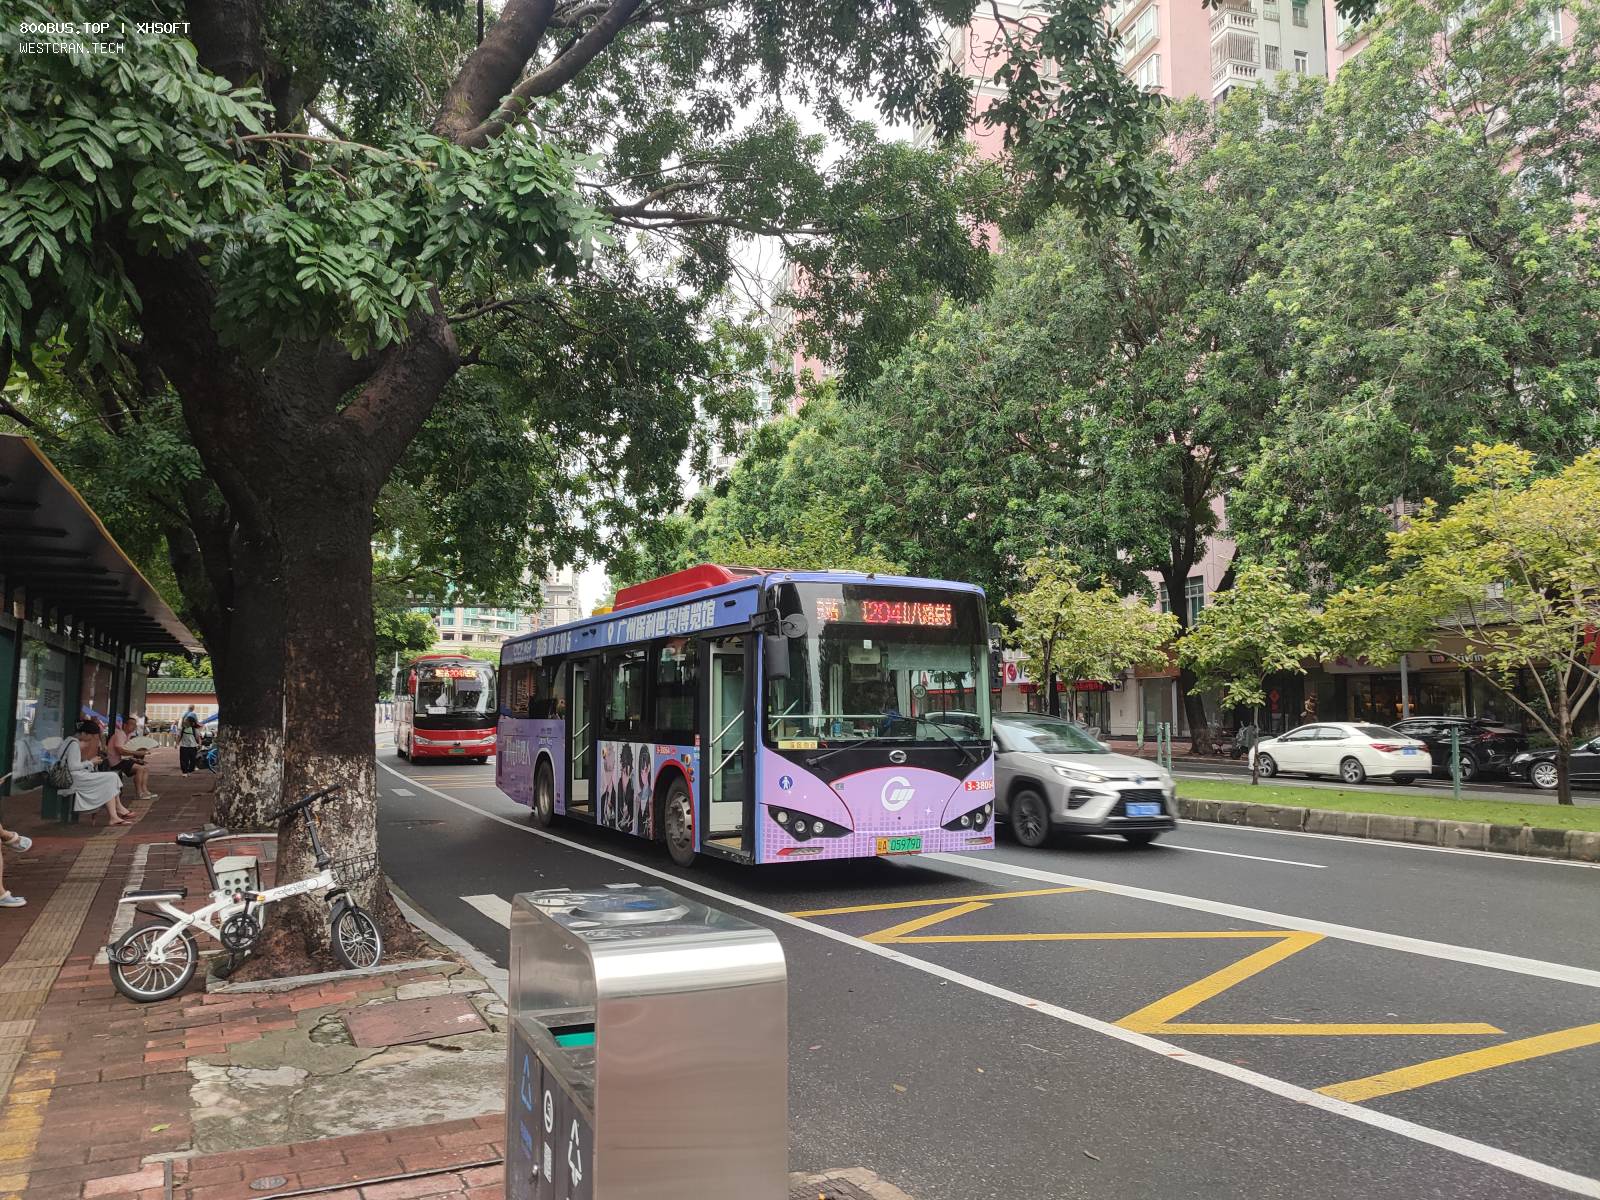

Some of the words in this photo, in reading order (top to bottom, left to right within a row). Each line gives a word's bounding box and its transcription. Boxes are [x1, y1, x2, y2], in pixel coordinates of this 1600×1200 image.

[617, 600, 716, 643] 广州保利世贸博览馆
